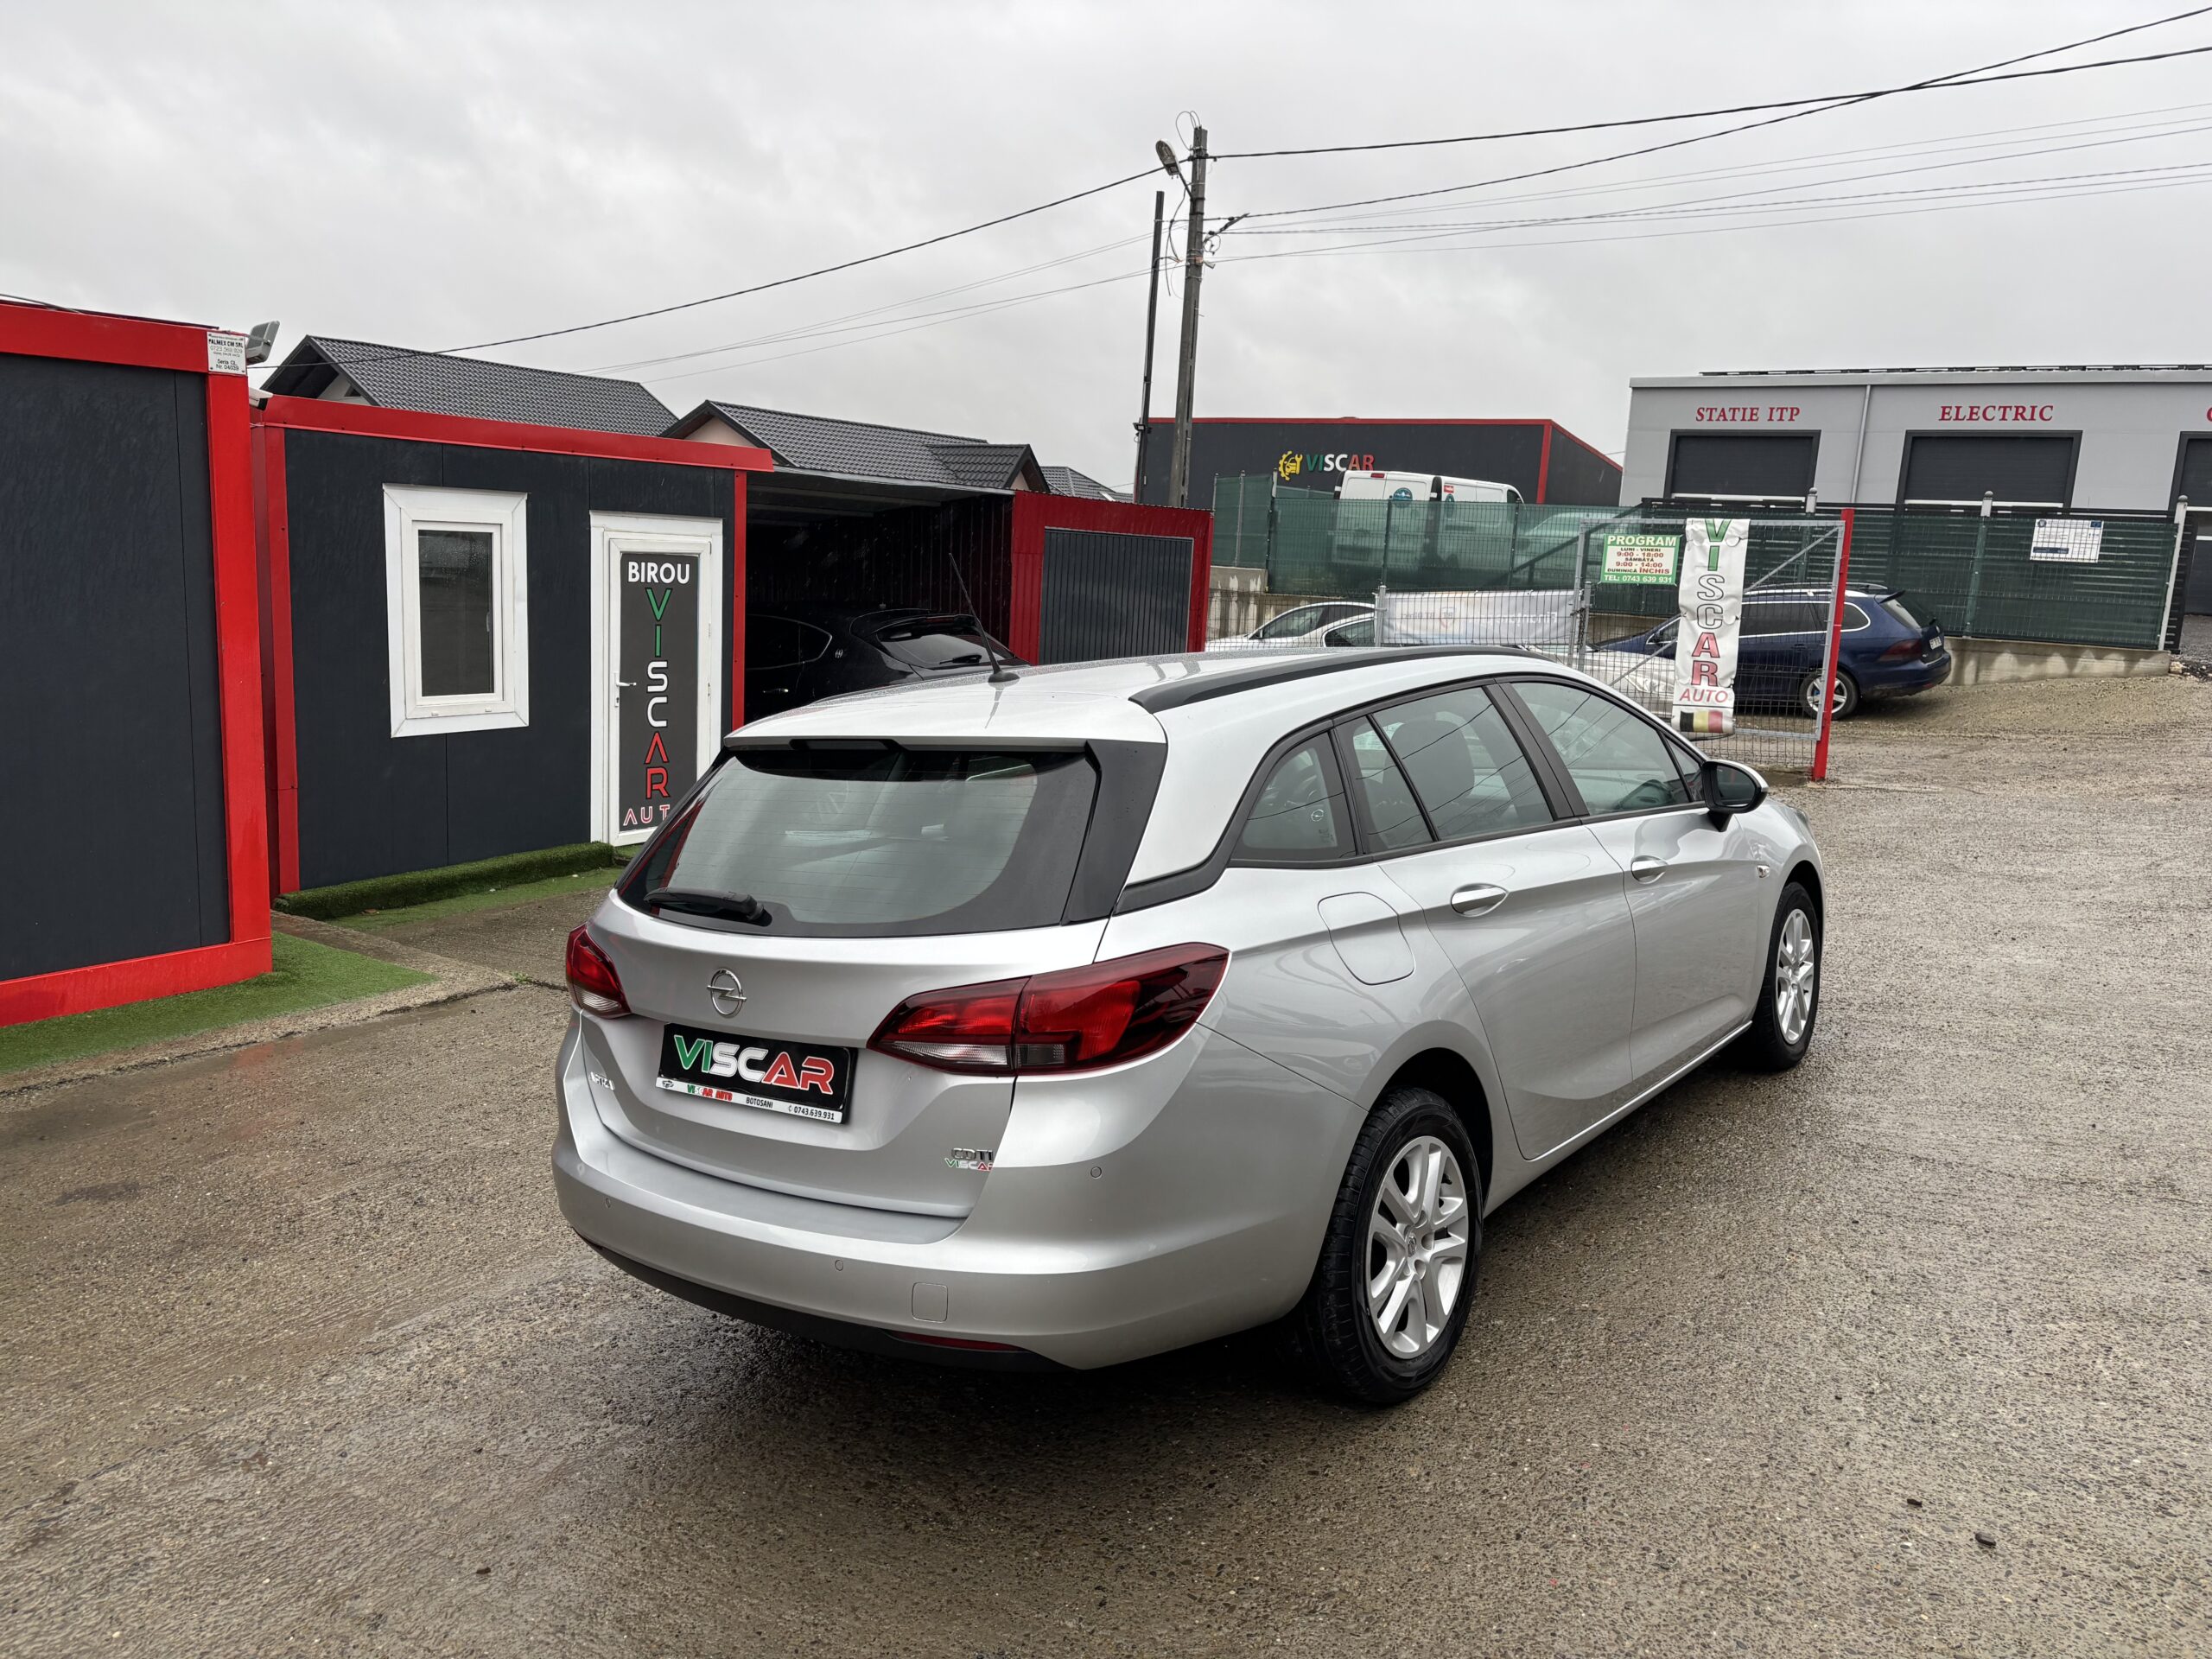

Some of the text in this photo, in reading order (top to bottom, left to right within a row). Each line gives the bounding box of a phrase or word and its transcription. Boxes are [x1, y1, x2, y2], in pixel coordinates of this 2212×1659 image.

[1695, 407, 1800, 422] STATIE ITP
[1938, 405, 2054, 421] ELECTRIC
[1306, 454, 1375, 472] VISCAR
[1607, 536, 1676, 547] PROGRAM
[627, 561, 690, 584] BIROU
[1691, 518, 1732, 687] VISCAR
[644, 588, 673, 799] VISCAR
[1679, 688, 1728, 702] AUTO
[623, 804, 671, 827] AUT
[674, 1034, 835, 1095] VISCAR
[687, 1084, 835, 1120] VISCAR AUTO BOTOSANI 0743.639.931
